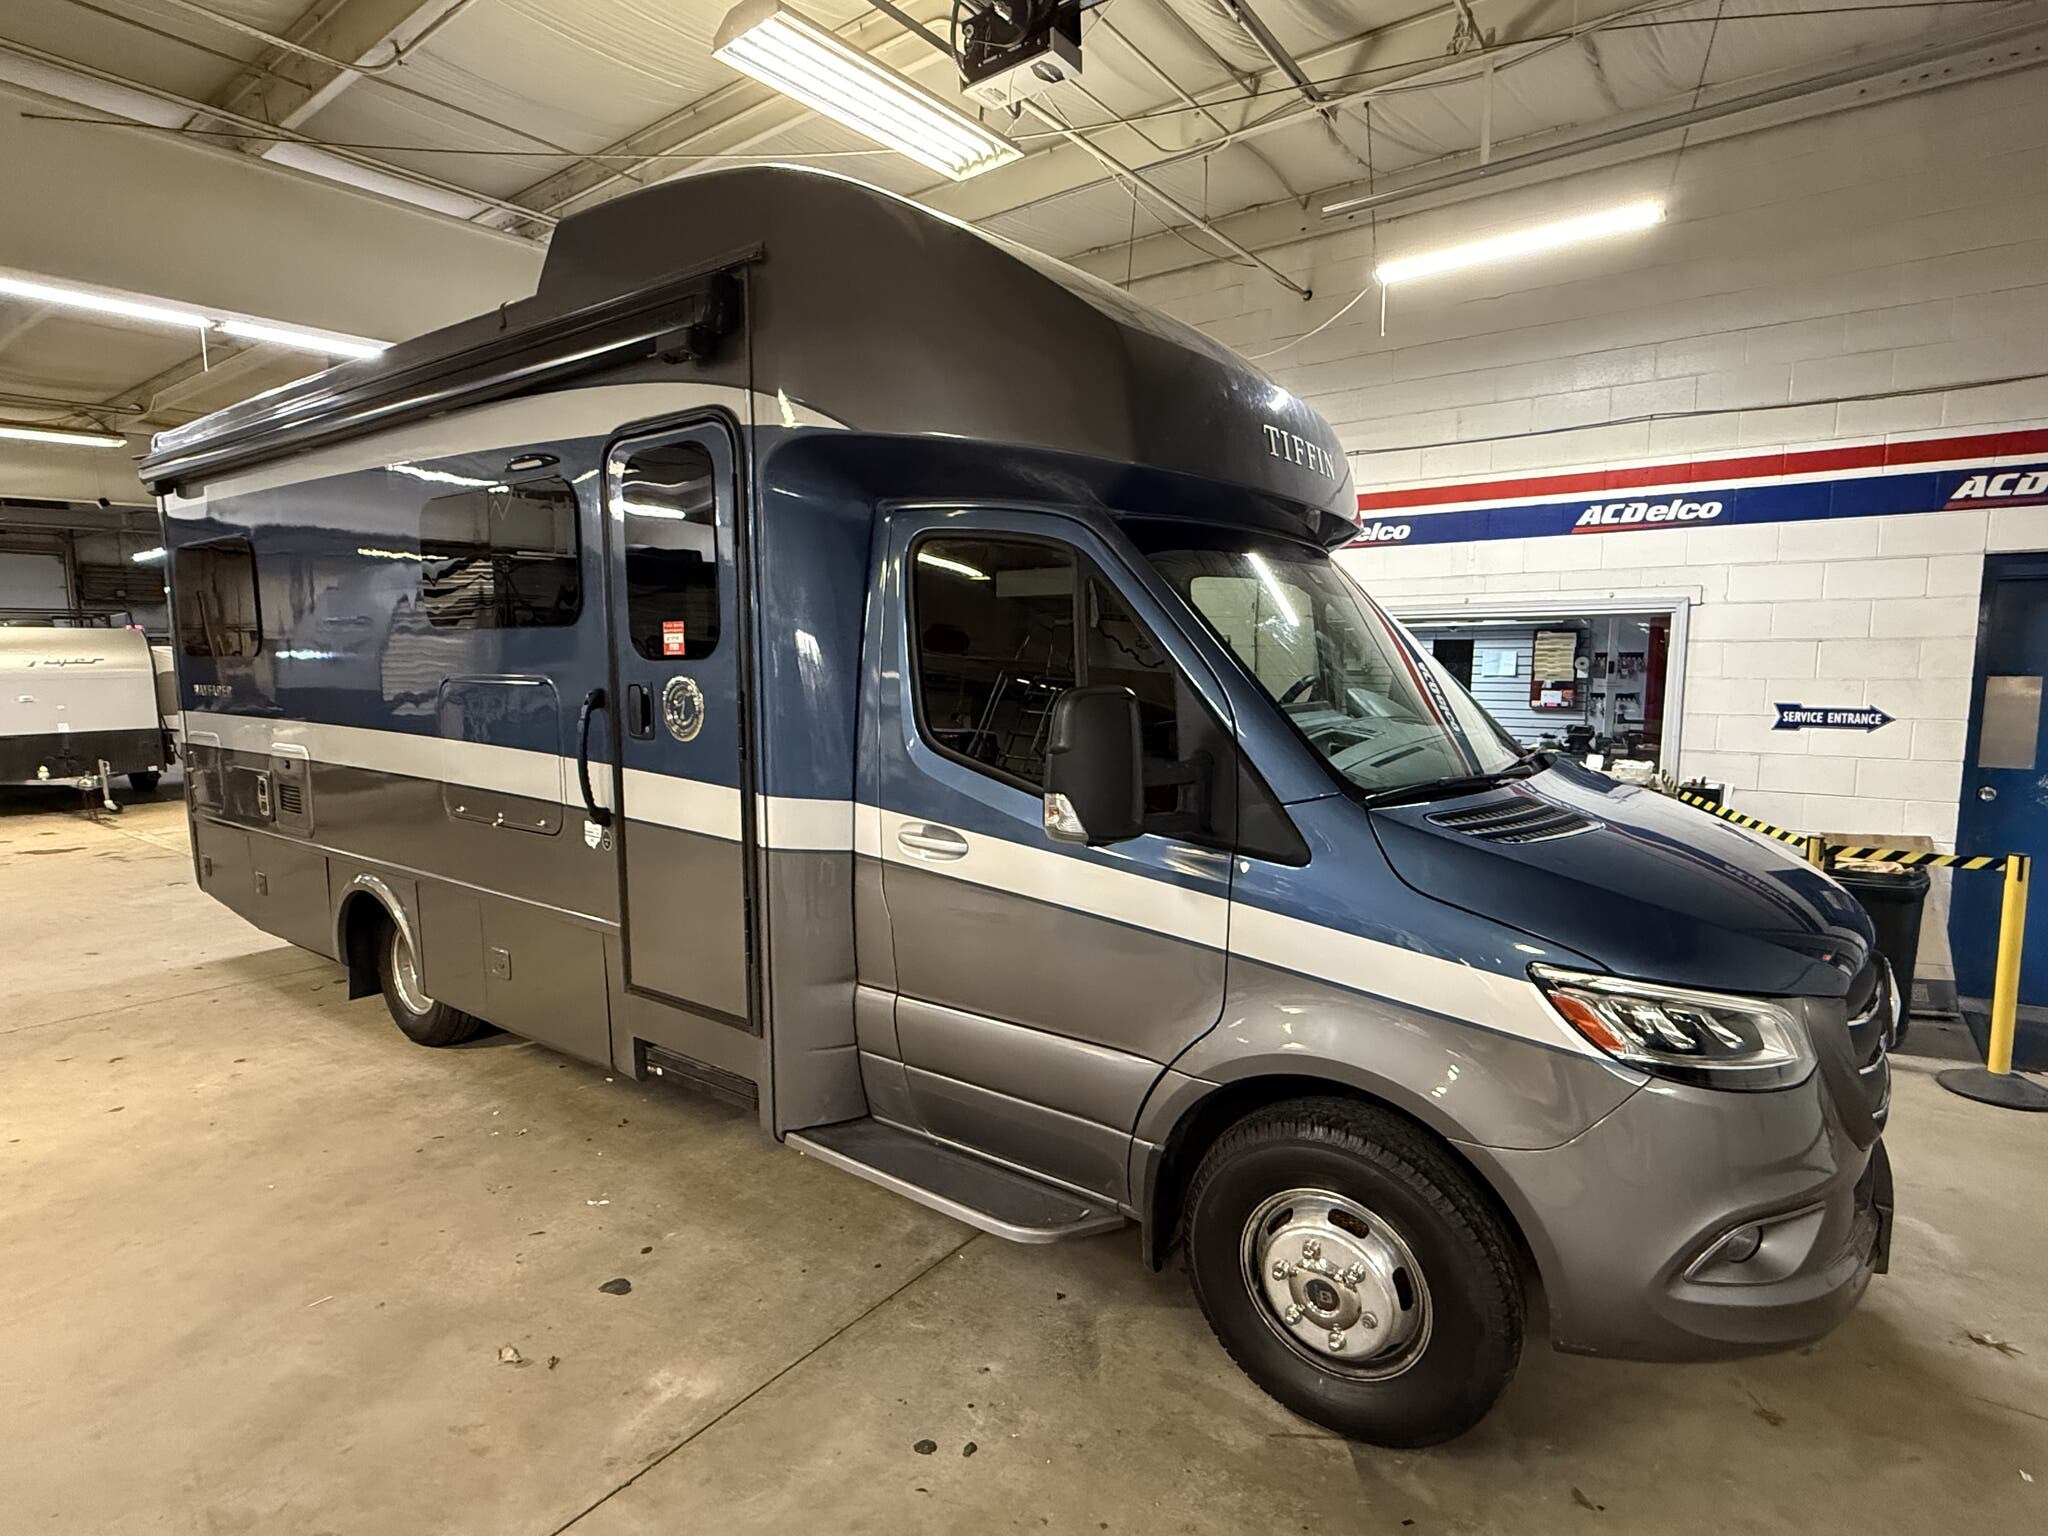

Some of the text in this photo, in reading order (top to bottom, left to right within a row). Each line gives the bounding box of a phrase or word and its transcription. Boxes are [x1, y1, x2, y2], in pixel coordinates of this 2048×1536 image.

[1263, 424, 1335, 480] TIFFIN
[1575, 499, 1723, 526] ACDelco
[1783, 711, 1882, 725] SERVICE ENTRANCE
